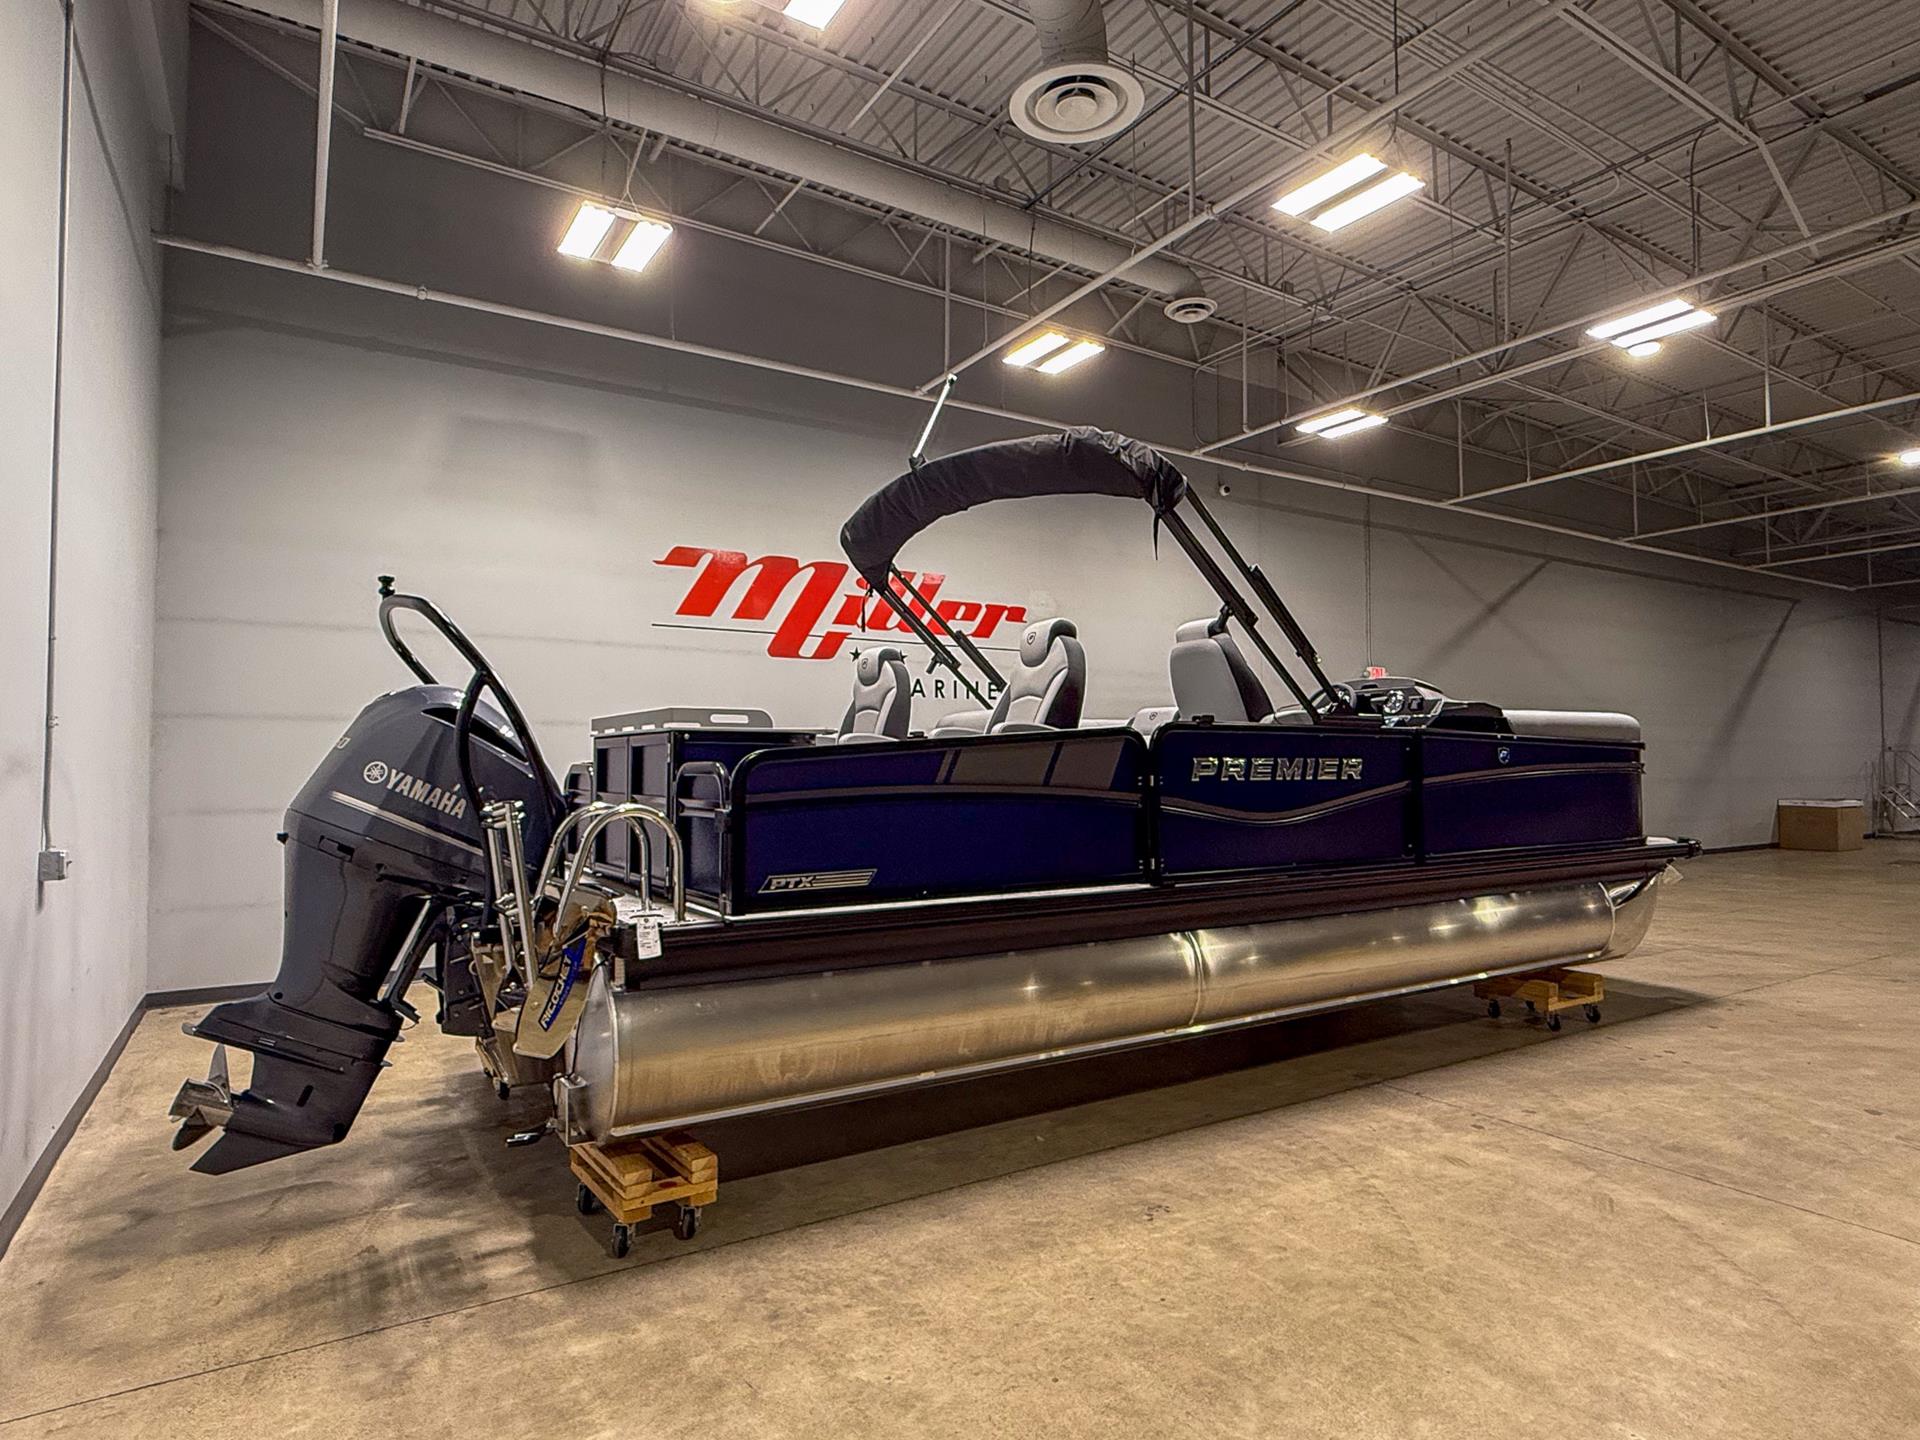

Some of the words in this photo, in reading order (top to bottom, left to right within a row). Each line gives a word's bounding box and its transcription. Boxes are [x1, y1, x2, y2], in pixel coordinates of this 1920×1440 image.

[910, 678, 998, 700] ARINE
[1191, 757, 1363, 782] PREMIER
[386, 768, 467, 819] YAMAHA
[770, 876, 814, 890] PTX
